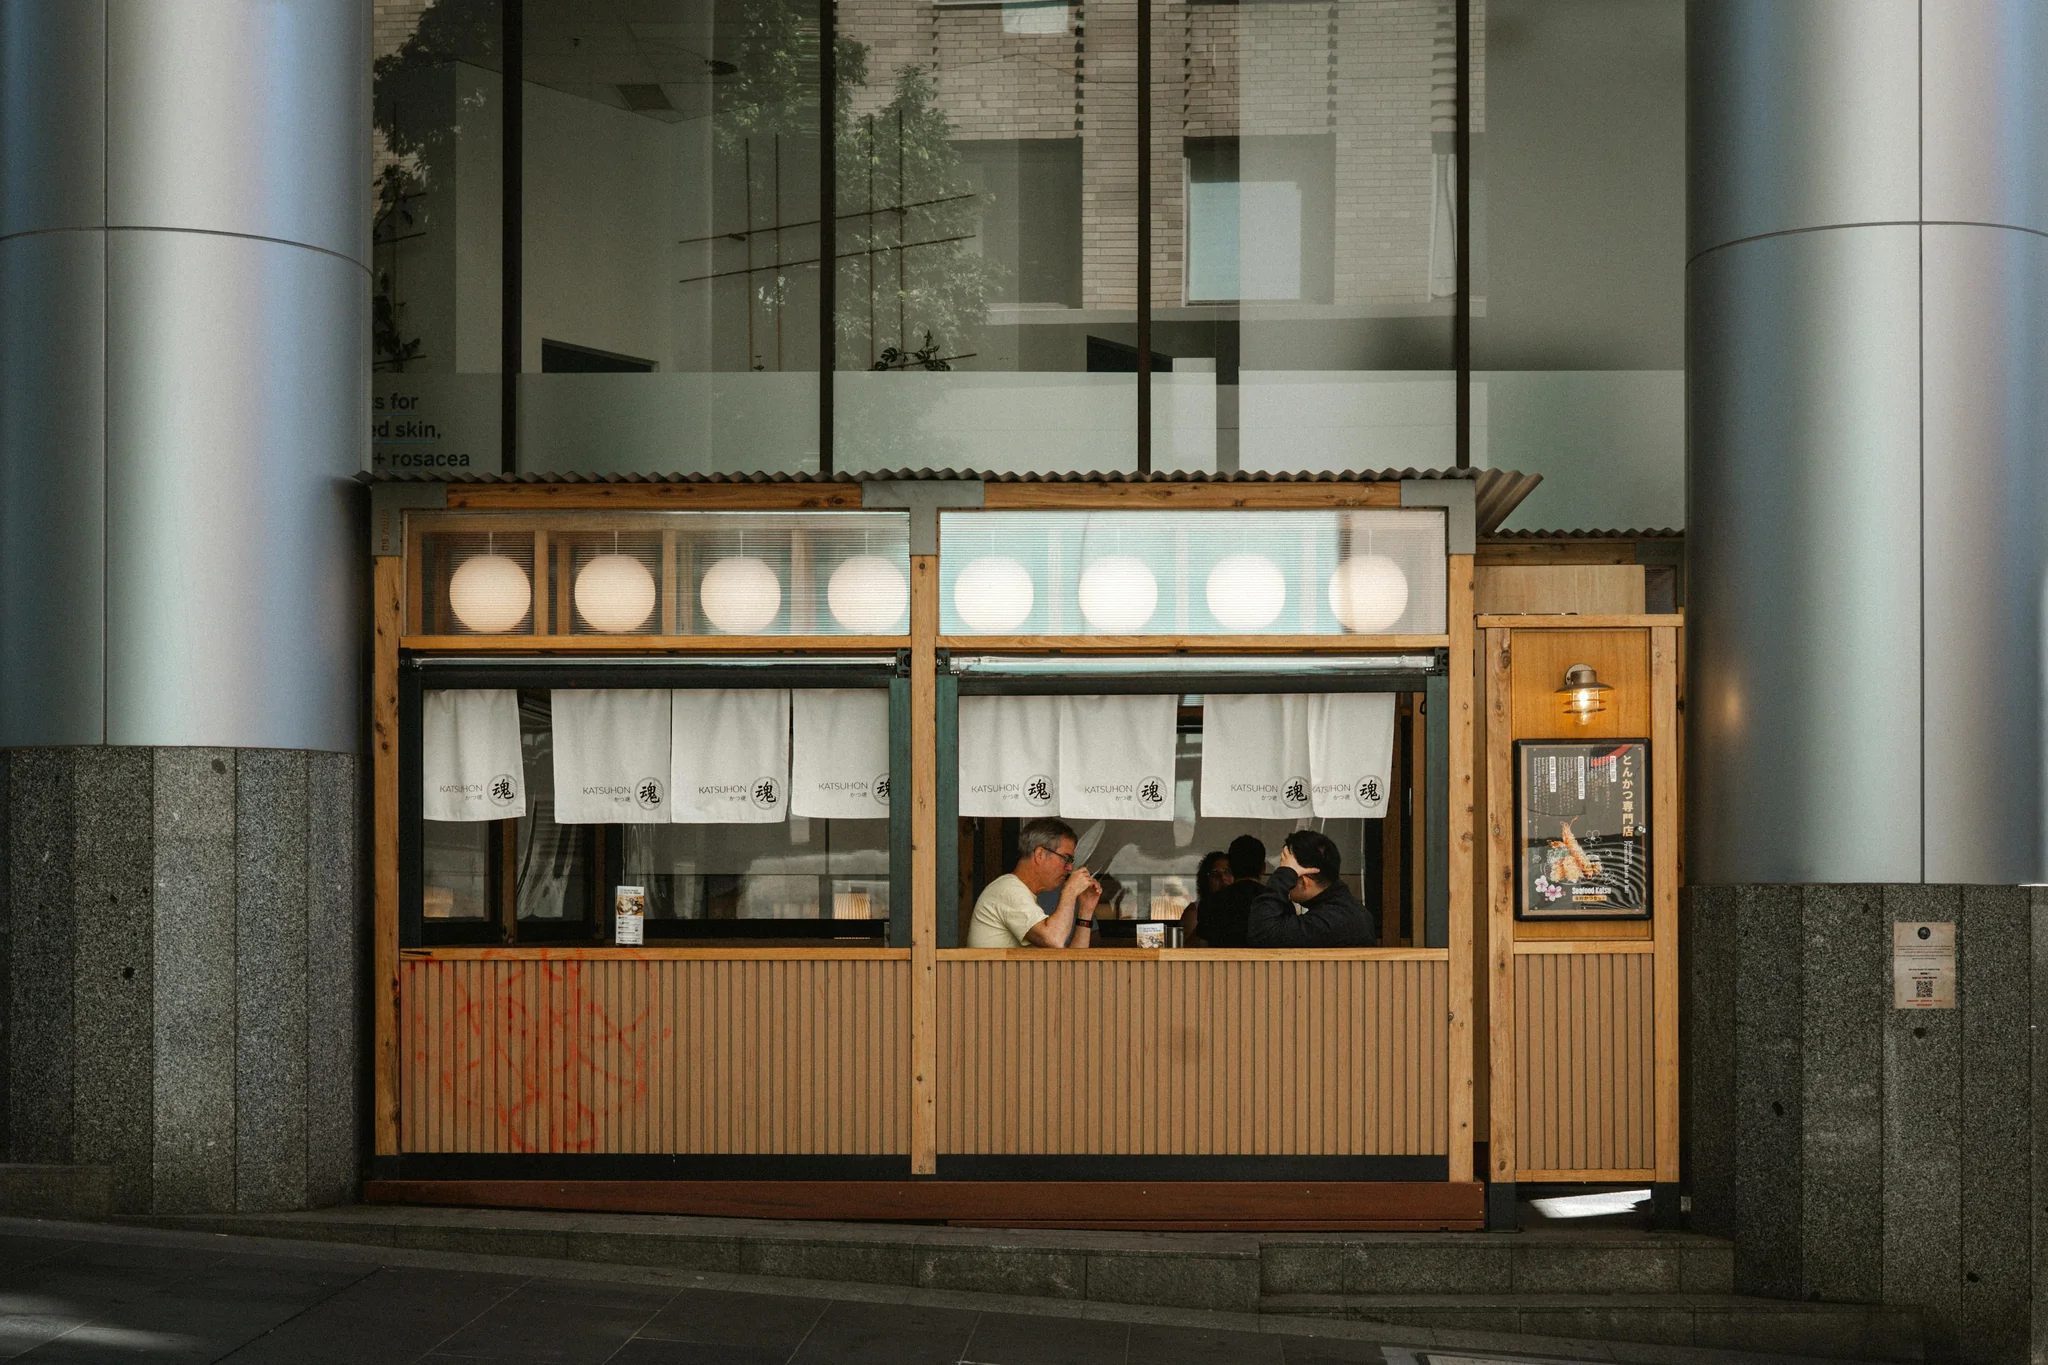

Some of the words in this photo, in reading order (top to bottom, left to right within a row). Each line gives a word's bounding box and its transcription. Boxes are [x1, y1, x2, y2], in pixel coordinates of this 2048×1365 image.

[372, 396, 385, 409] s
[390, 392, 419, 410] for
[395, 420, 441, 438] skin,
[373, 453, 385, 465] +
[392, 452, 470, 467] rosacea
[492, 778, 514, 800] 魂
[582, 786, 631, 795] KATSUHON
[639, 782, 660, 803] 魂
[698, 785, 747, 794] KATSUHON
[755, 781, 777, 803] 魂
[818, 781, 868, 790] KATSUHON
[971, 783, 1020, 793] KATSUHON
[1028, 778, 1050, 800] 魂
[1084, 784, 1133, 794] KATSUHON
[1141, 780, 1163, 802] 魂
[1230, 783, 1278, 793] KATSUHON
[1285, 780, 1308, 802] 魂
[1359, 779, 1381, 801] 魂
[1622, 755, 1635, 837] とんかつ専門店
[1571, 886, 1595, 895] Seafood
[1595, 886, 1612, 895] Katsu
